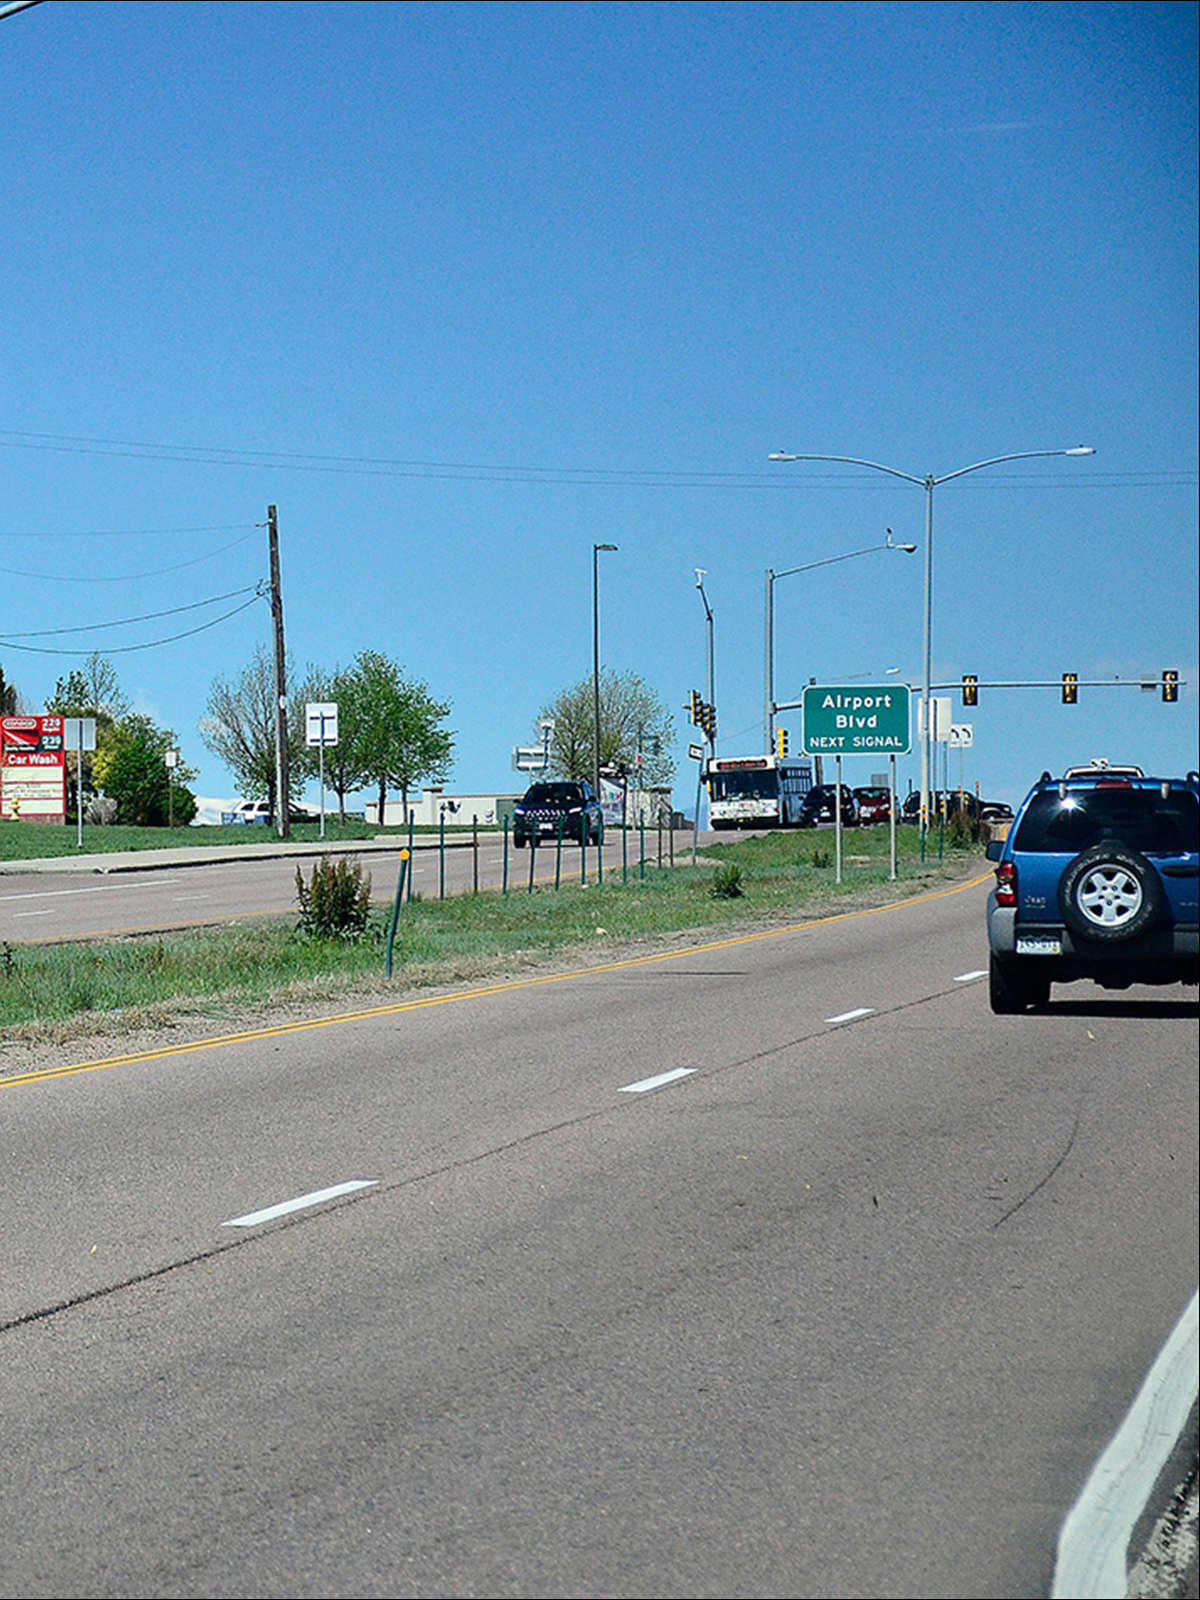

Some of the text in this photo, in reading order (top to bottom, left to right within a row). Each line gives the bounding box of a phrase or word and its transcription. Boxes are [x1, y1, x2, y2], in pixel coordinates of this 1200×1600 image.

[821, 695, 892, 710] Airport
[836, 715, 878, 728] Blvd
[810, 736, 903, 747] NEXT SIGNAL
[8, 754, 58, 765] Car Wash
